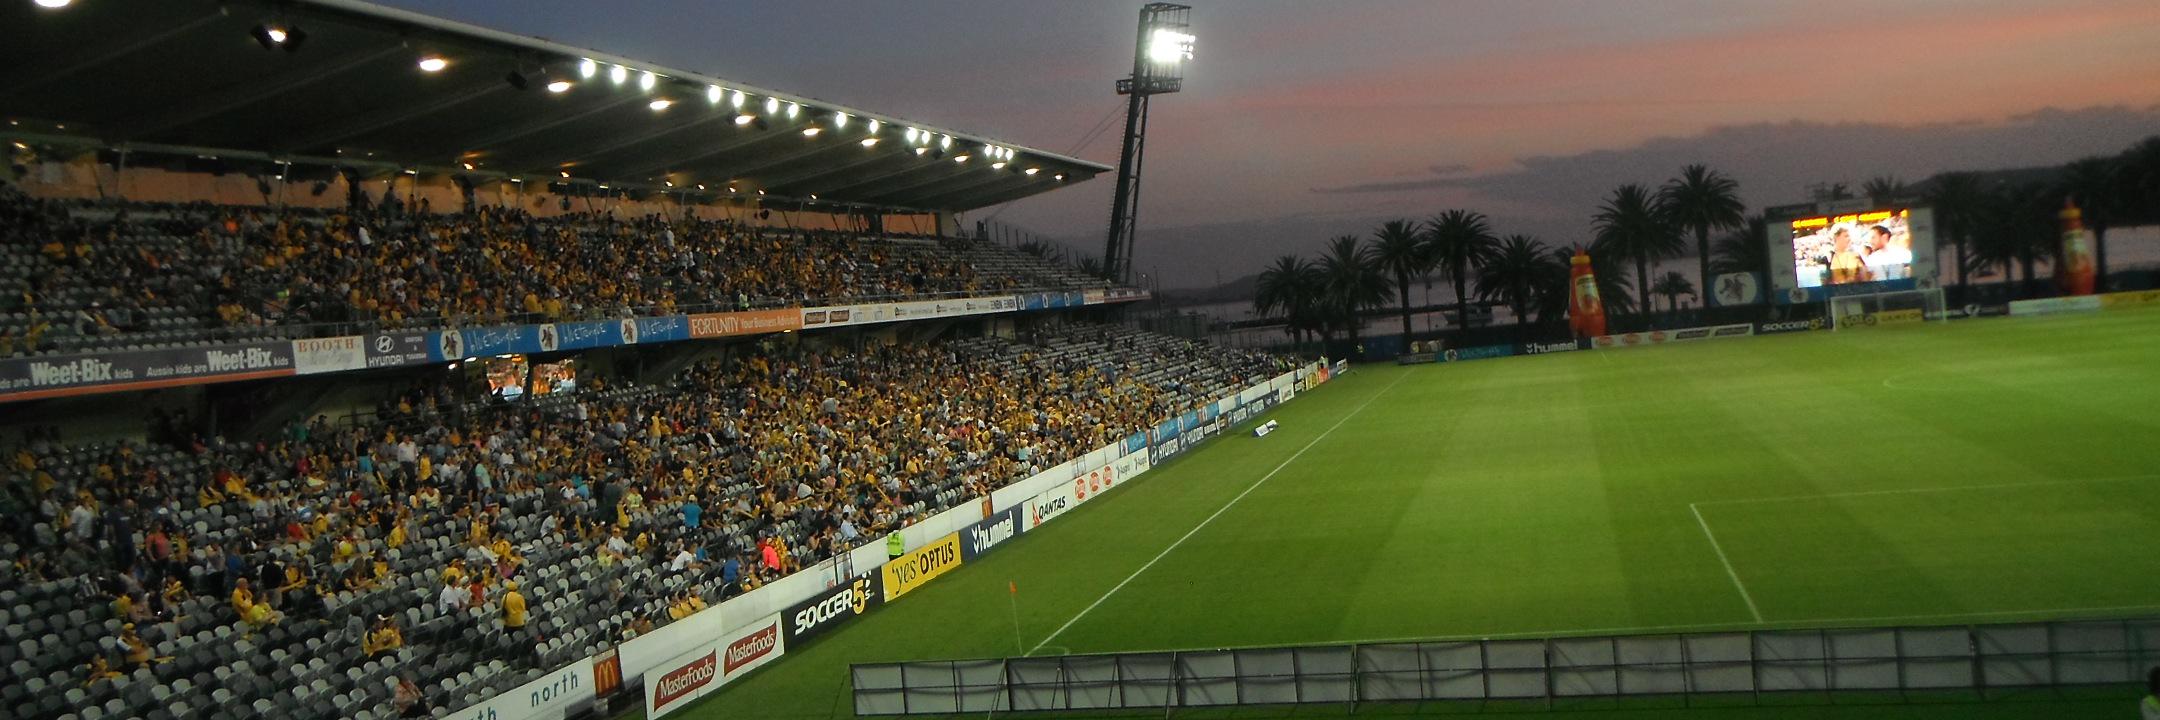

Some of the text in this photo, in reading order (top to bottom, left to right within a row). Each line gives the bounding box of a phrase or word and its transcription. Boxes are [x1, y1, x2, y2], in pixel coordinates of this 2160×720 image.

[206, 347, 272, 372] Weet-Bix
[298, 338, 354, 353] BOOTH
[1533, 339, 1577, 354] hummel
[30, 358, 112, 386] Weet-Bix
[368, 354, 405, 367] HYUNDAI
[1038, 495, 1066, 519] QANTAS
[978, 509, 1014, 552] hummel
[919, 541, 954, 576] OPTUS
[728, 629, 775, 666] MasterFoods
[531, 670, 579, 708] north
[660, 658, 714, 700] MasterFoods
